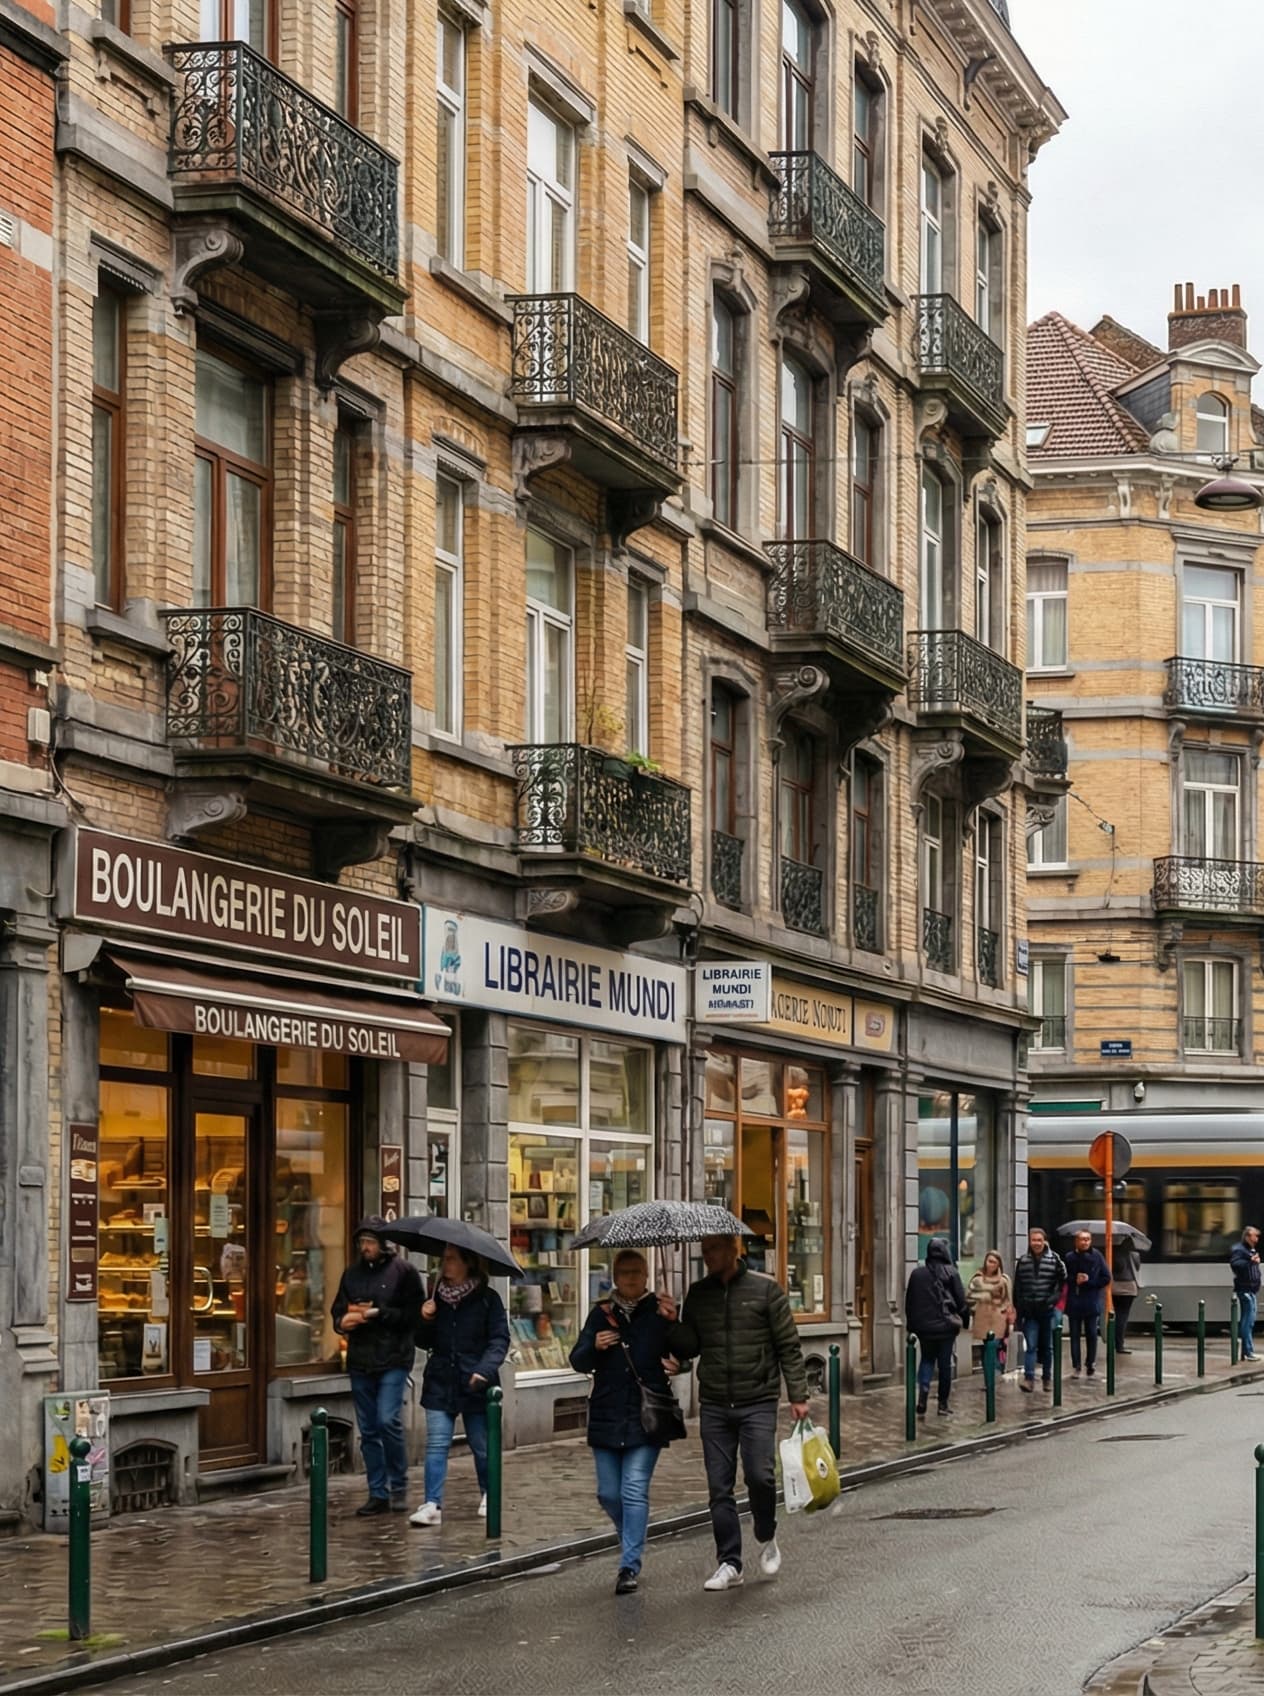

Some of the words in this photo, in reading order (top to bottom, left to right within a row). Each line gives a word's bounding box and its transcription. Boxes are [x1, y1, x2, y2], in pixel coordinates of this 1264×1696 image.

[91, 847, 286, 939] BOULANGERIE
[293, 893, 326, 947] DU
[331, 901, 410, 964] SOLEIL
[484, 941, 602, 1009] LIBRAIRIE
[608, 968, 676, 1023] MUNDI
[702, 968, 762, 980] LIBRAIRIE
[712, 983, 752, 995] MUNDI
[194, 1005, 318, 1047] BOULANGERIE
[321, 1022, 343, 1050] DU
[348, 1026, 401, 1058] SOLEIL
